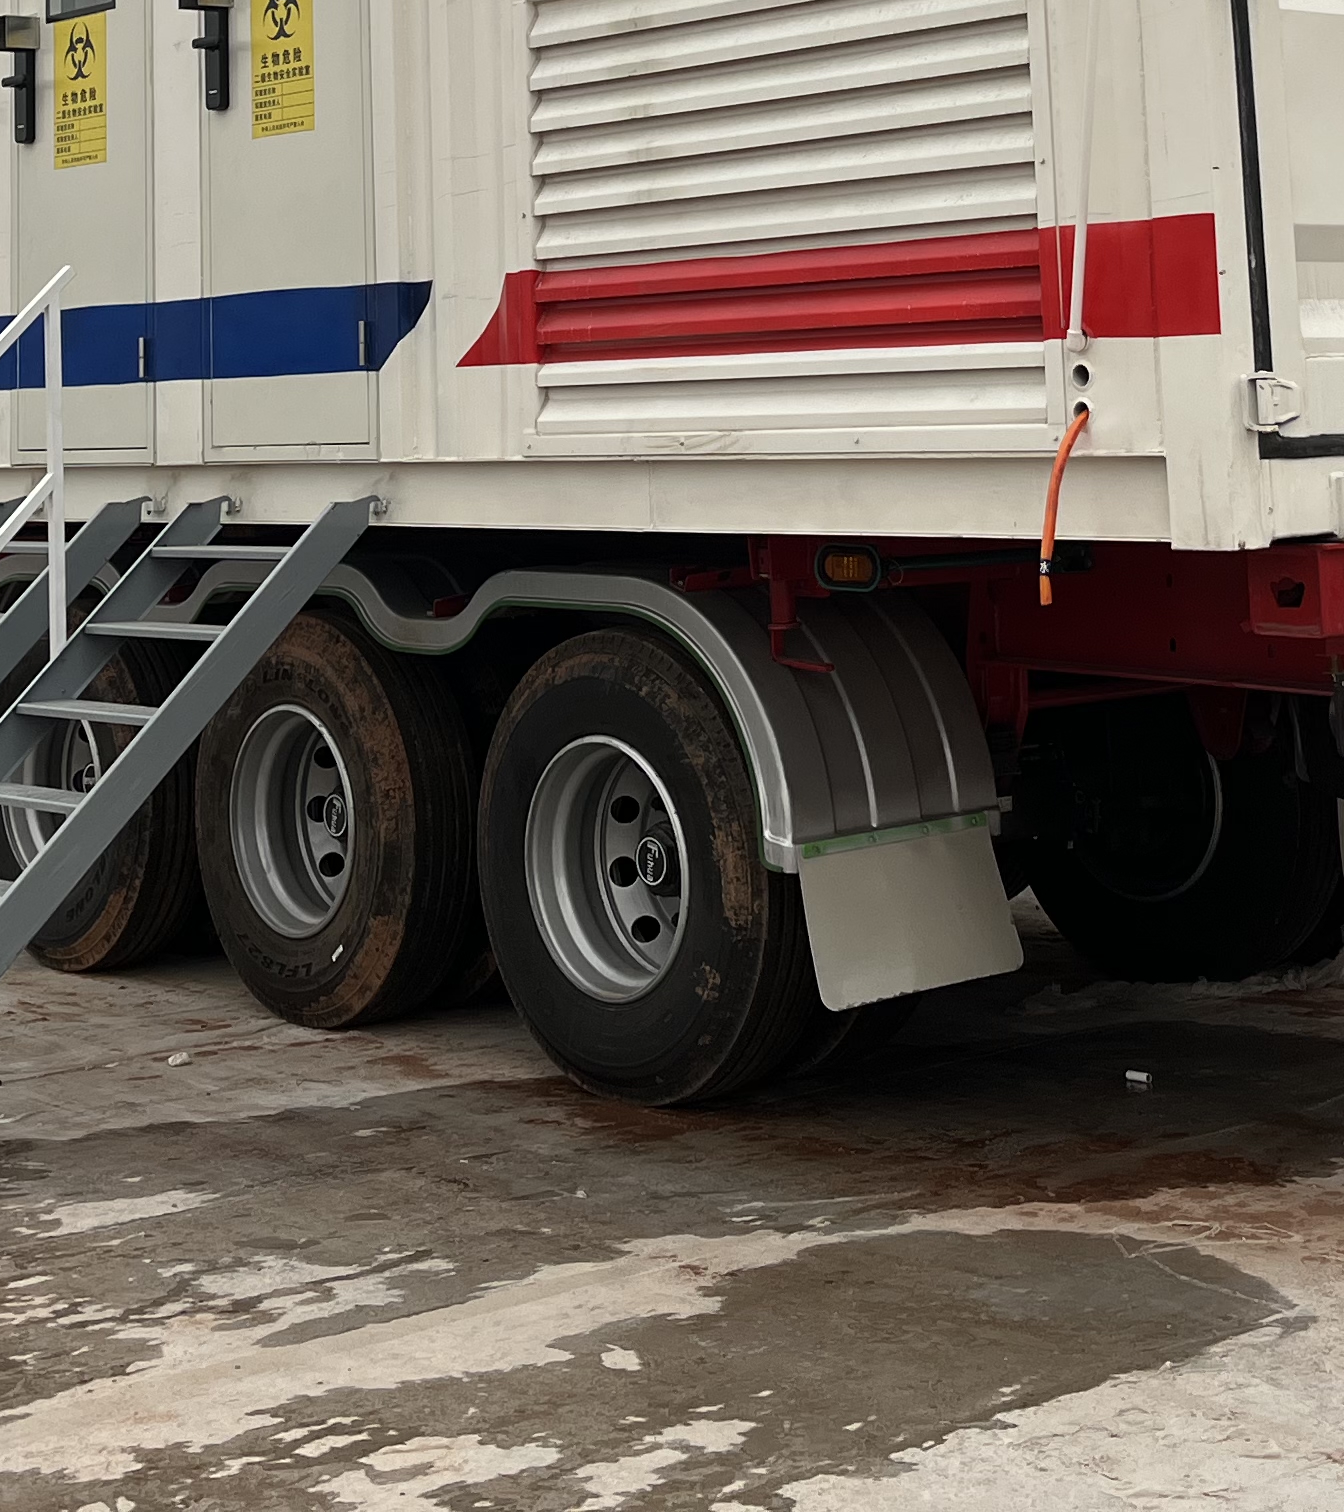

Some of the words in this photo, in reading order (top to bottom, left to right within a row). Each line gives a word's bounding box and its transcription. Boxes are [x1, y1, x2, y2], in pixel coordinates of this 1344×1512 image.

[261, 47, 302, 69] 生物危险
[254, 65, 310, 84] 二级生物安全实验室
[61, 87, 97, 106] 生物危险
[646, 840, 659, 882] Fuhua
